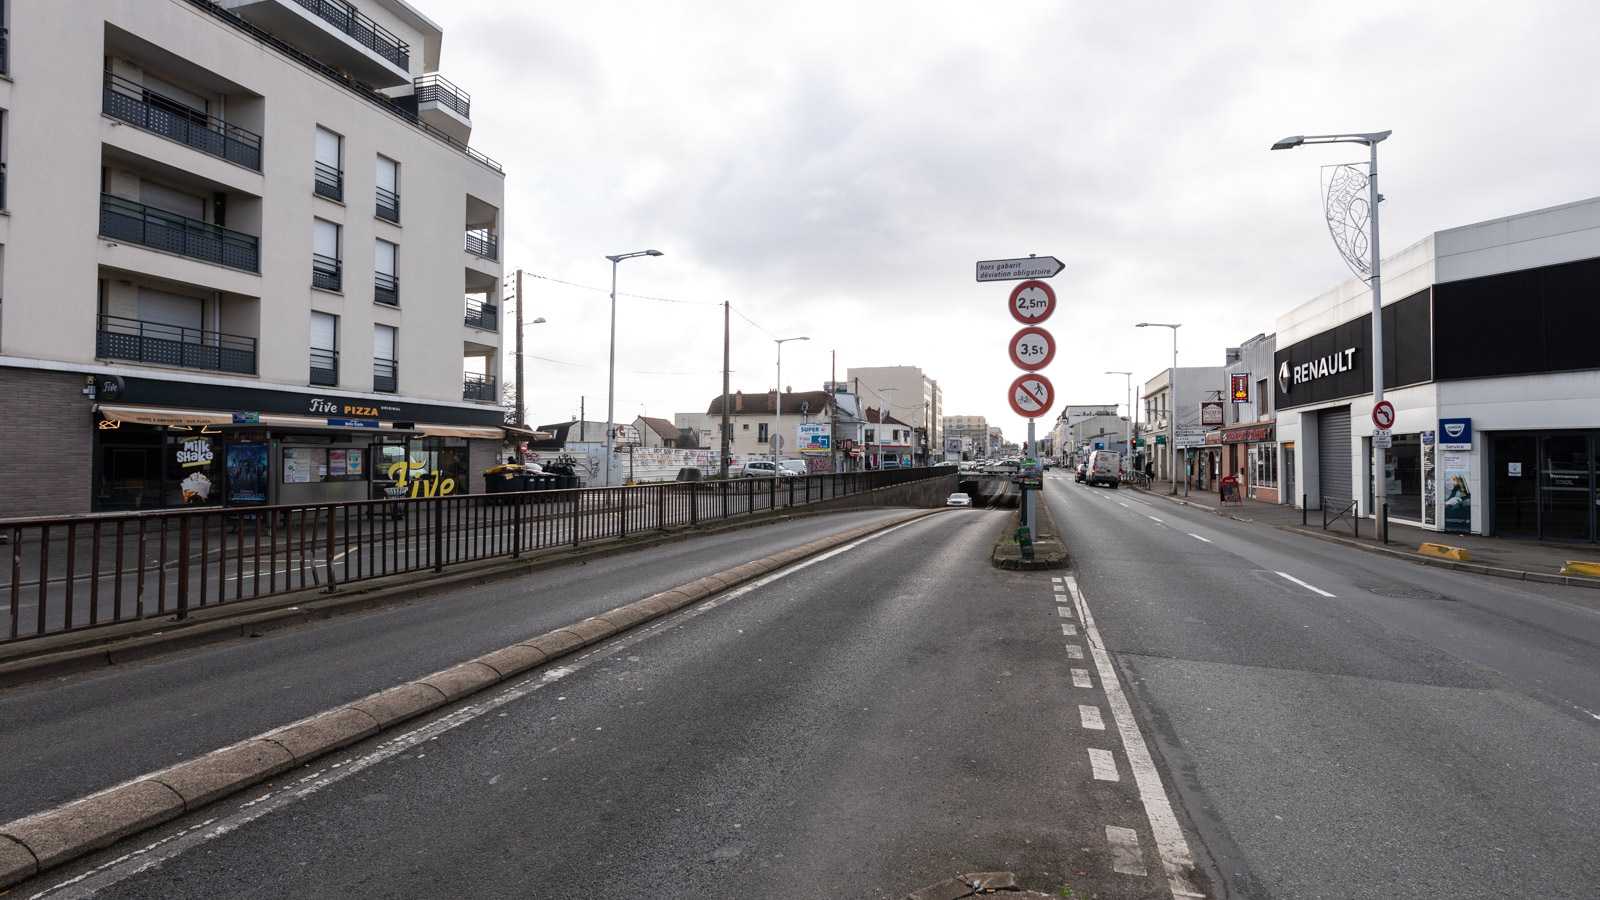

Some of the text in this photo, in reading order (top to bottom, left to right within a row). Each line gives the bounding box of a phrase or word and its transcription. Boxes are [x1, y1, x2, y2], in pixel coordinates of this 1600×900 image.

[997, 262, 1021, 271] gabarit
[1013, 268, 1051, 277] obligatoire
[1018, 298, 1047, 310] 2,5m
[1021, 344, 1044, 357] 3,5t
[1293, 347, 1356, 385] RENAULT
[103, 381, 117, 392] Five
[309, 398, 338, 413] Five
[344, 405, 379, 416] PIZZA
[183, 439, 210, 453] Milk
[387, 459, 456, 500] Five
